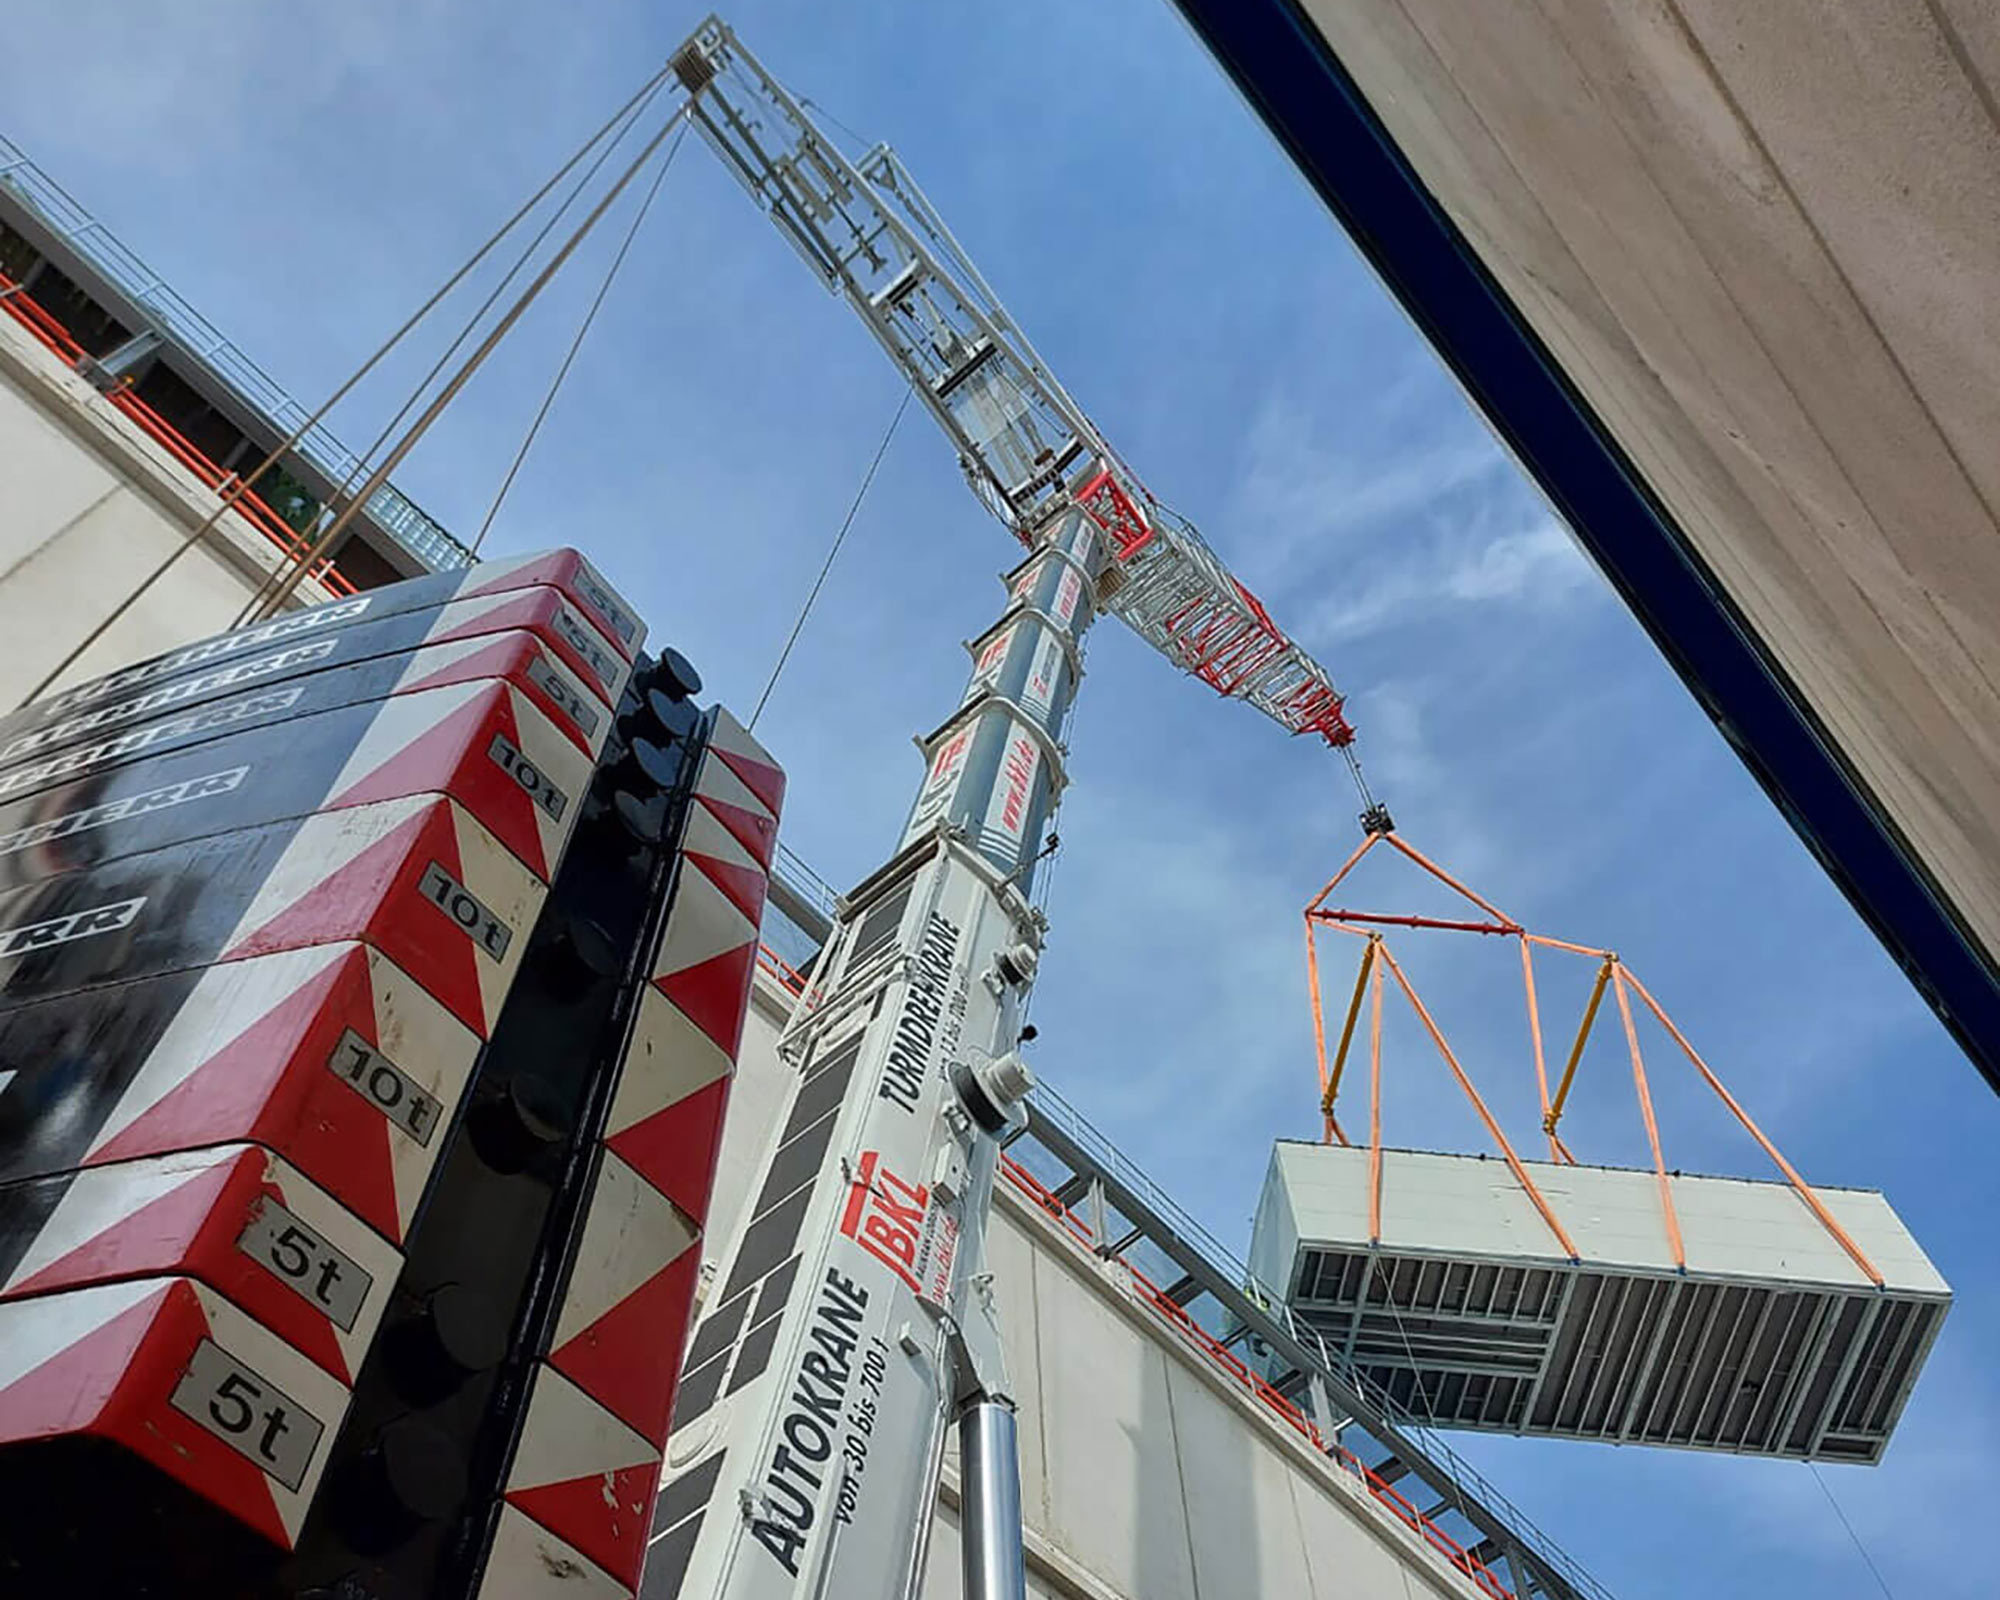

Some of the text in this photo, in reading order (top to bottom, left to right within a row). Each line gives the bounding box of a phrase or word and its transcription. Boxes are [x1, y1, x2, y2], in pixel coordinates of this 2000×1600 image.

[0, 897, 148, 958] RR
[879, 911, 961, 1114] TURMDREHKRANE
[751, 1267, 869, 1579] AUTOKRANE
[836, 1336, 890, 1525] von 30 bis 700 t
